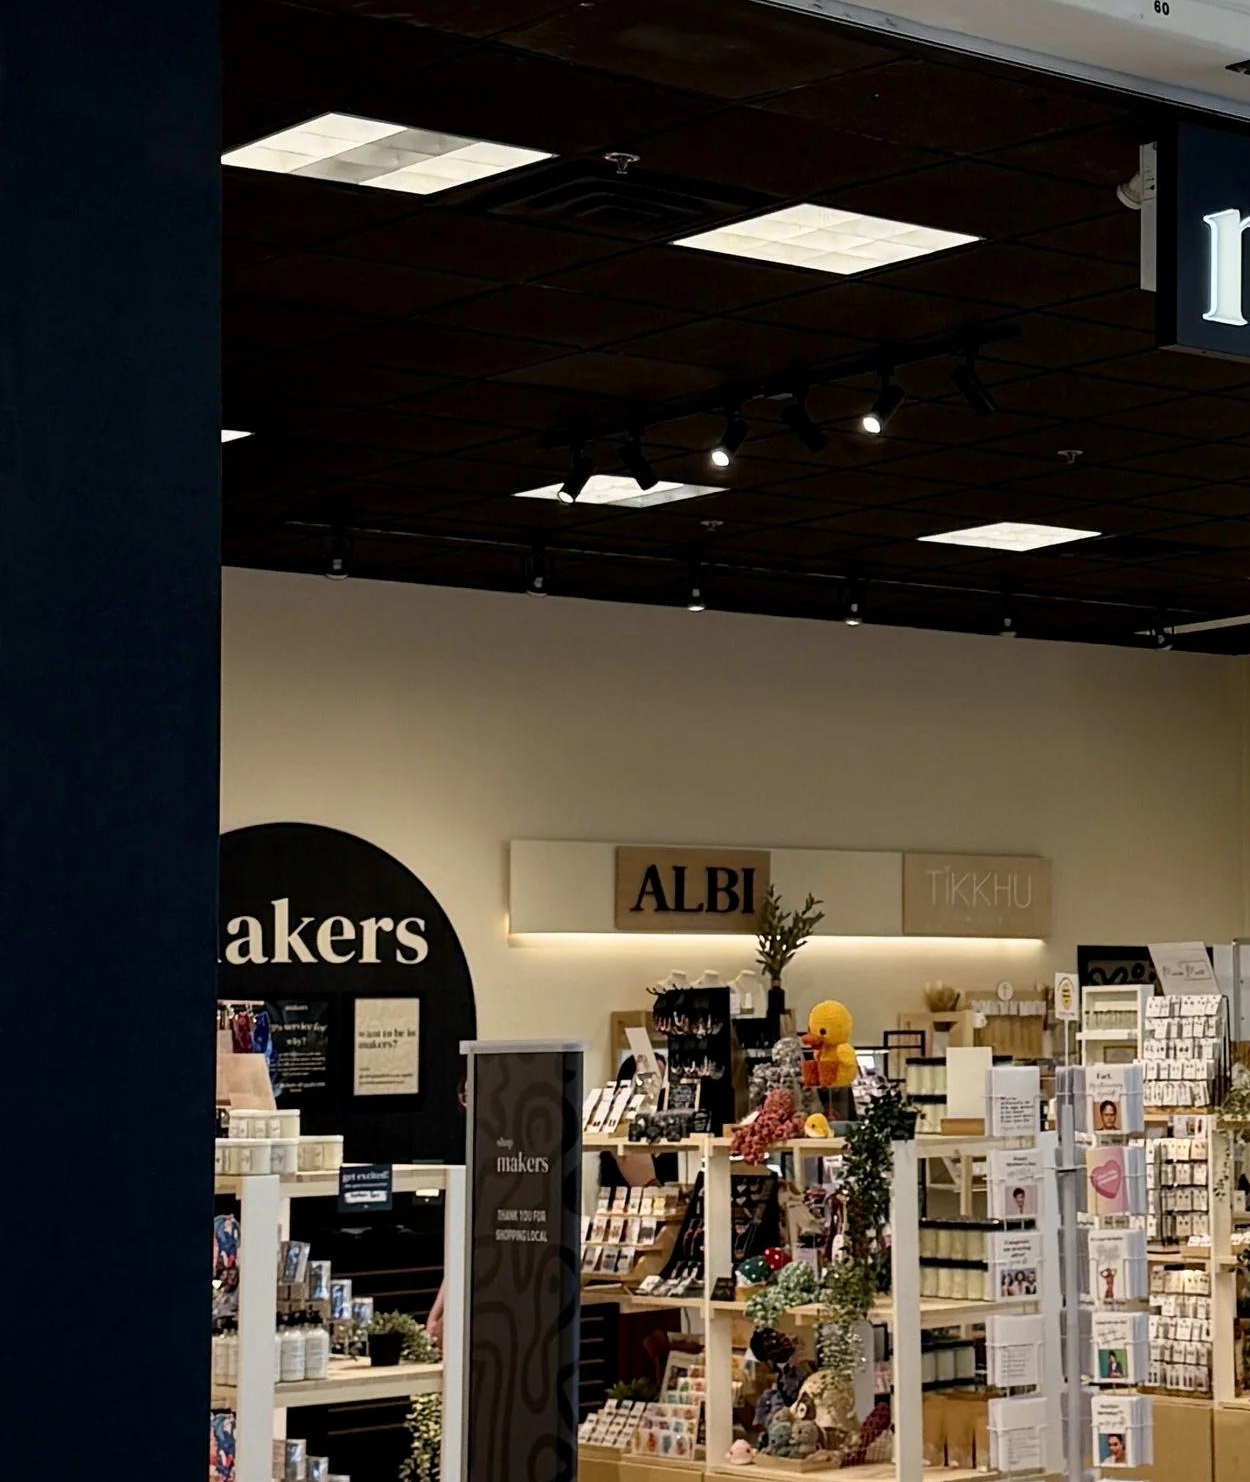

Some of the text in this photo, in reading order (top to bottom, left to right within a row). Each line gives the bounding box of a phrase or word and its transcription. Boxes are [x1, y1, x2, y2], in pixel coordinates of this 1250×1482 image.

[1153, 0, 1171, 16] 60
[629, 864, 755, 915] ALBI
[216, 897, 430, 966] akers
[394, 1029, 405, 1037] be
[358, 1040, 398, 1049] makers?
[497, 1151, 549, 1173] makers
[497, 1209, 546, 1222] THANK YOU FOR
[495, 1229, 548, 1242] SHOPPING LOCAL
